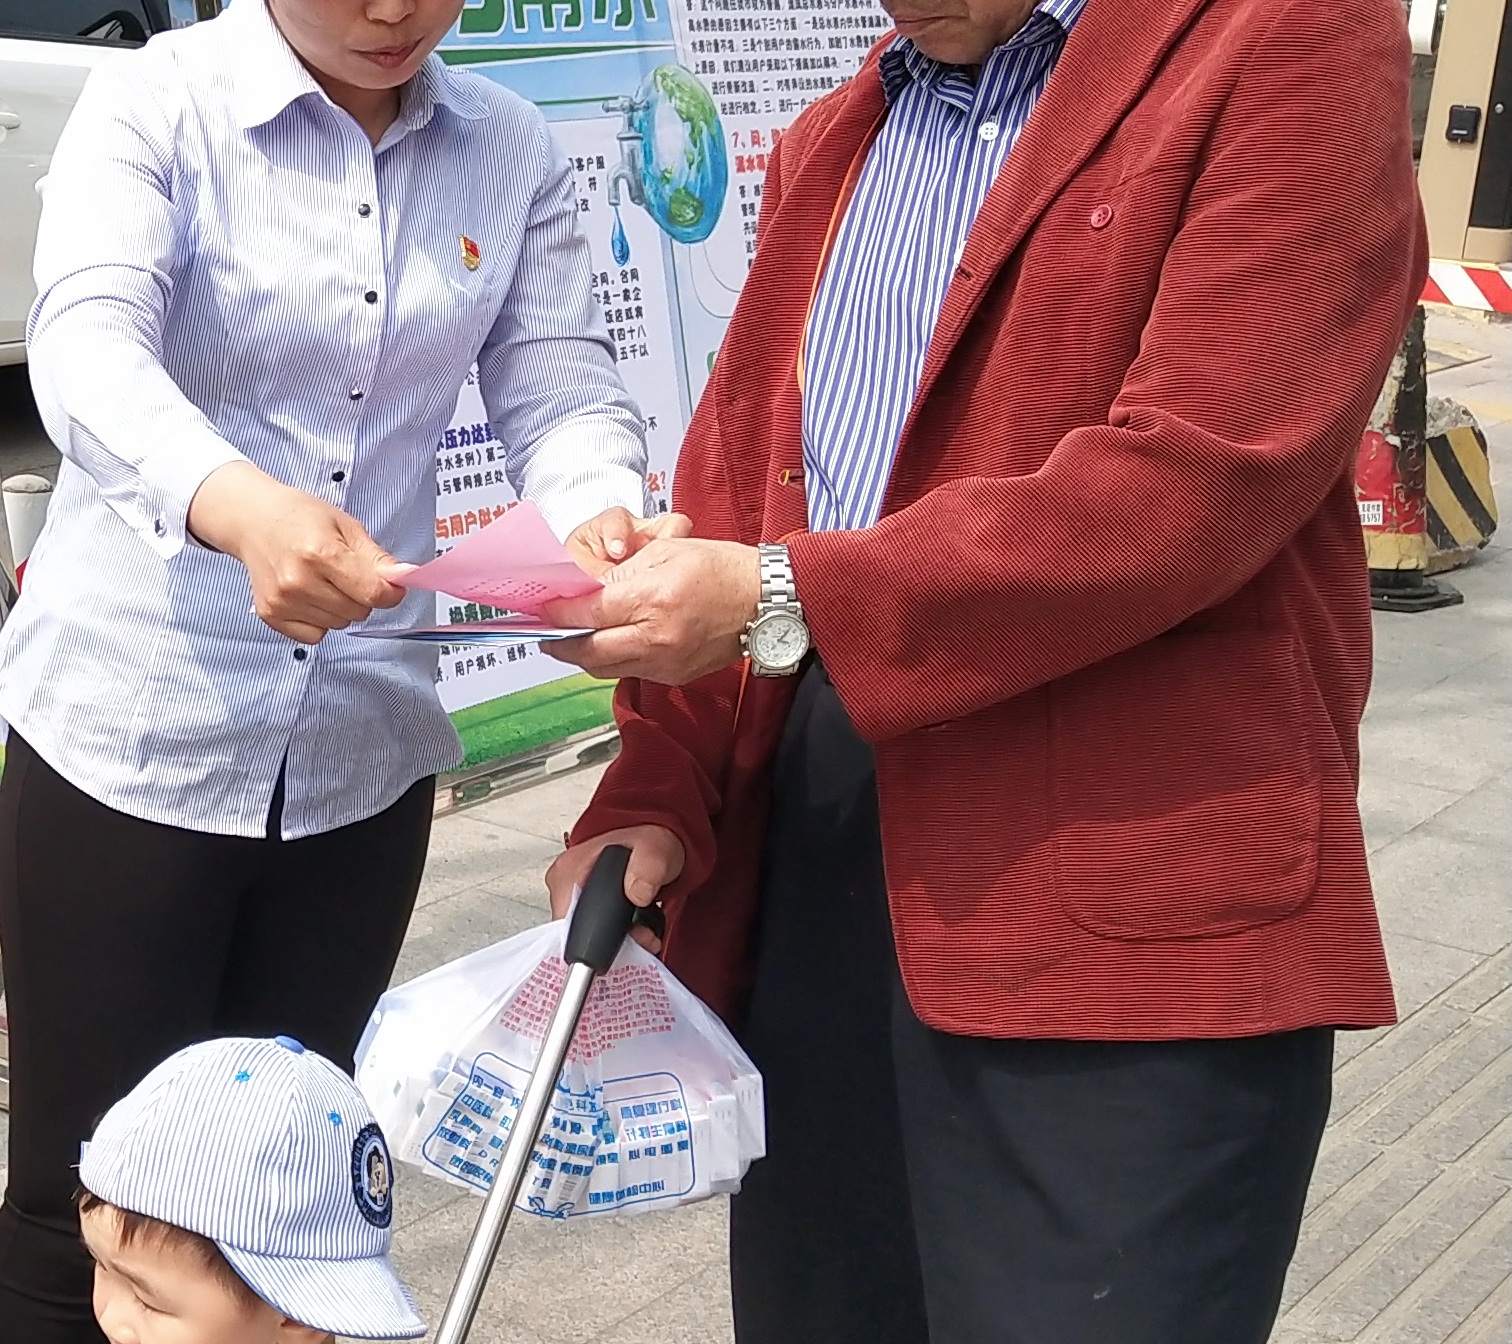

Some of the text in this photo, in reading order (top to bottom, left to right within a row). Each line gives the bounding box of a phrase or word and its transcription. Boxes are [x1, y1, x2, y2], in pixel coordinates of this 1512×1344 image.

[436, 501, 518, 540] 与用户供水
